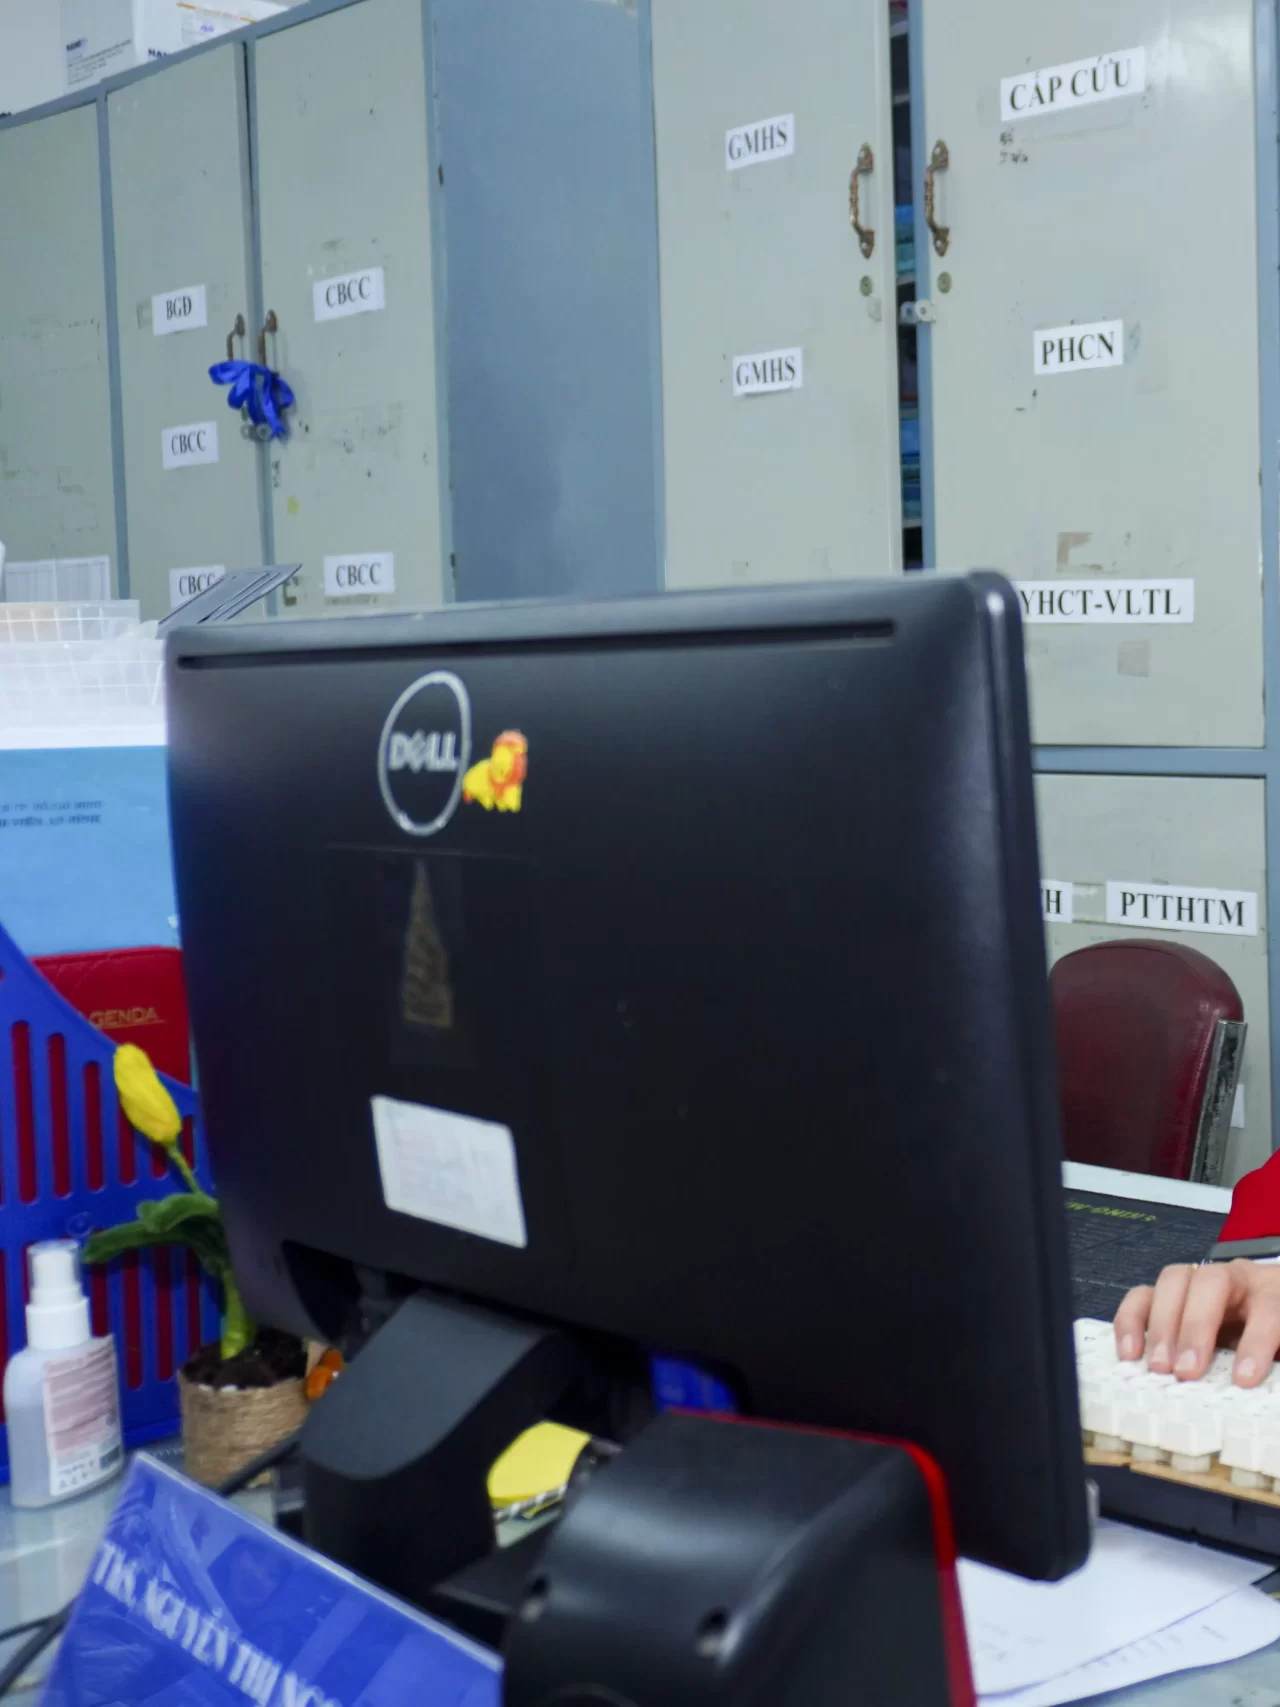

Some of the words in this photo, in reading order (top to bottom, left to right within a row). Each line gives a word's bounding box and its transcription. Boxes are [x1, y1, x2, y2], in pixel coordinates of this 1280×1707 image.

[1010, 71, 1062, 111] CẤP
[1071, 56, 1131, 97] CỨU
[728, 122, 788, 161] GMHS
[325, 276, 371, 308] CBCC
[165, 295, 192, 321] BGD
[1041, 332, 1116, 366] PHCN
[735, 355, 796, 386] GMHS
[171, 430, 207, 456] CBCC
[336, 562, 382, 588] CBCC
[1020, 588, 1182, 616] YHCT-VLTL
[389, 729, 457, 774] DELL
[1119, 891, 1245, 927] PTTHTM
[89, 1007, 158, 1029] GENDA
